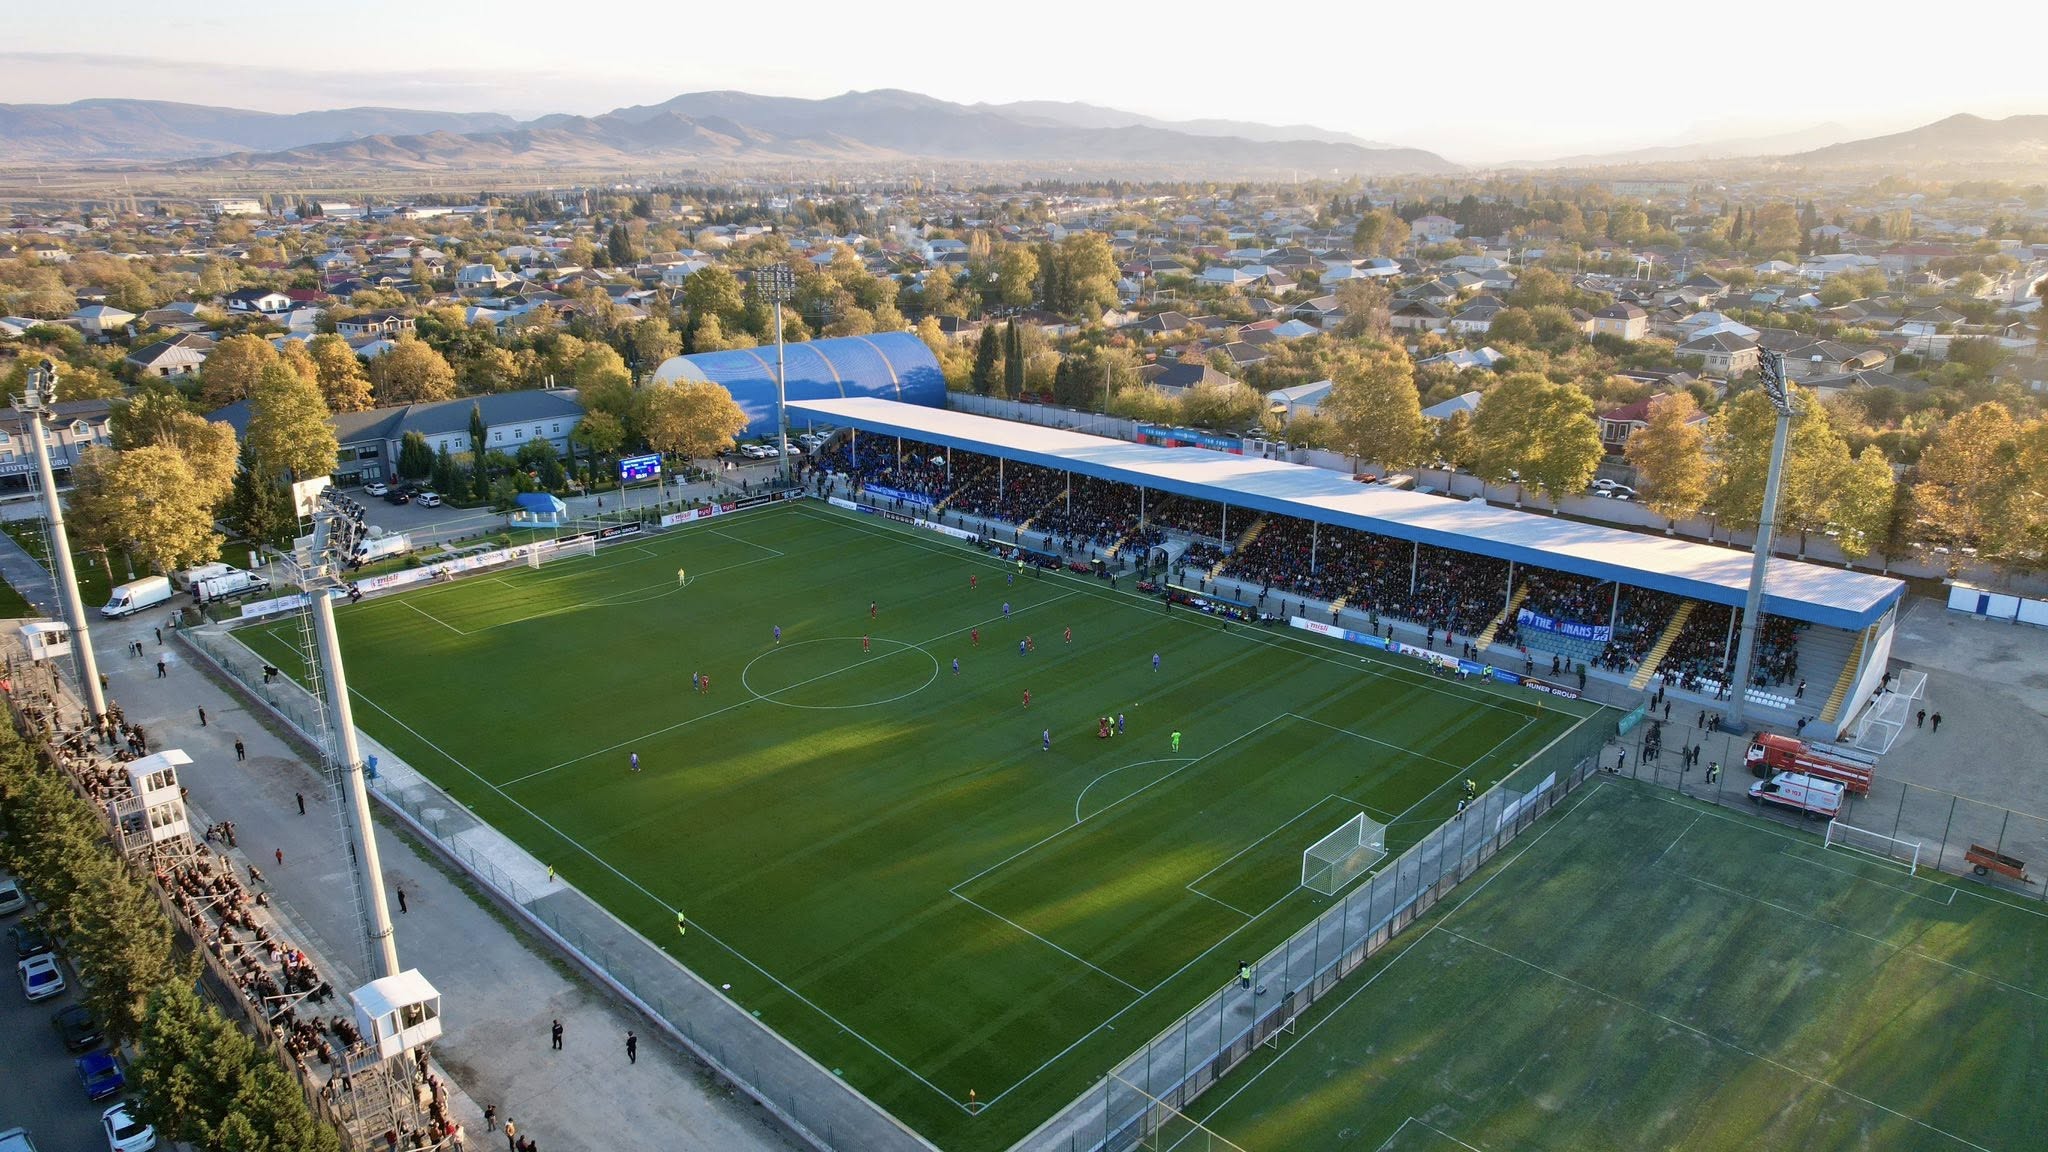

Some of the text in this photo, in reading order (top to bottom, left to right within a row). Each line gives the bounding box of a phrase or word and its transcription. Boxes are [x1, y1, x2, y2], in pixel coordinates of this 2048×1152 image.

[376, 573, 399, 585] misli
[1309, 622, 1329, 632] misli
[1534, 616, 1553, 630] THE
[1551, 688, 1577, 700] GROUP
